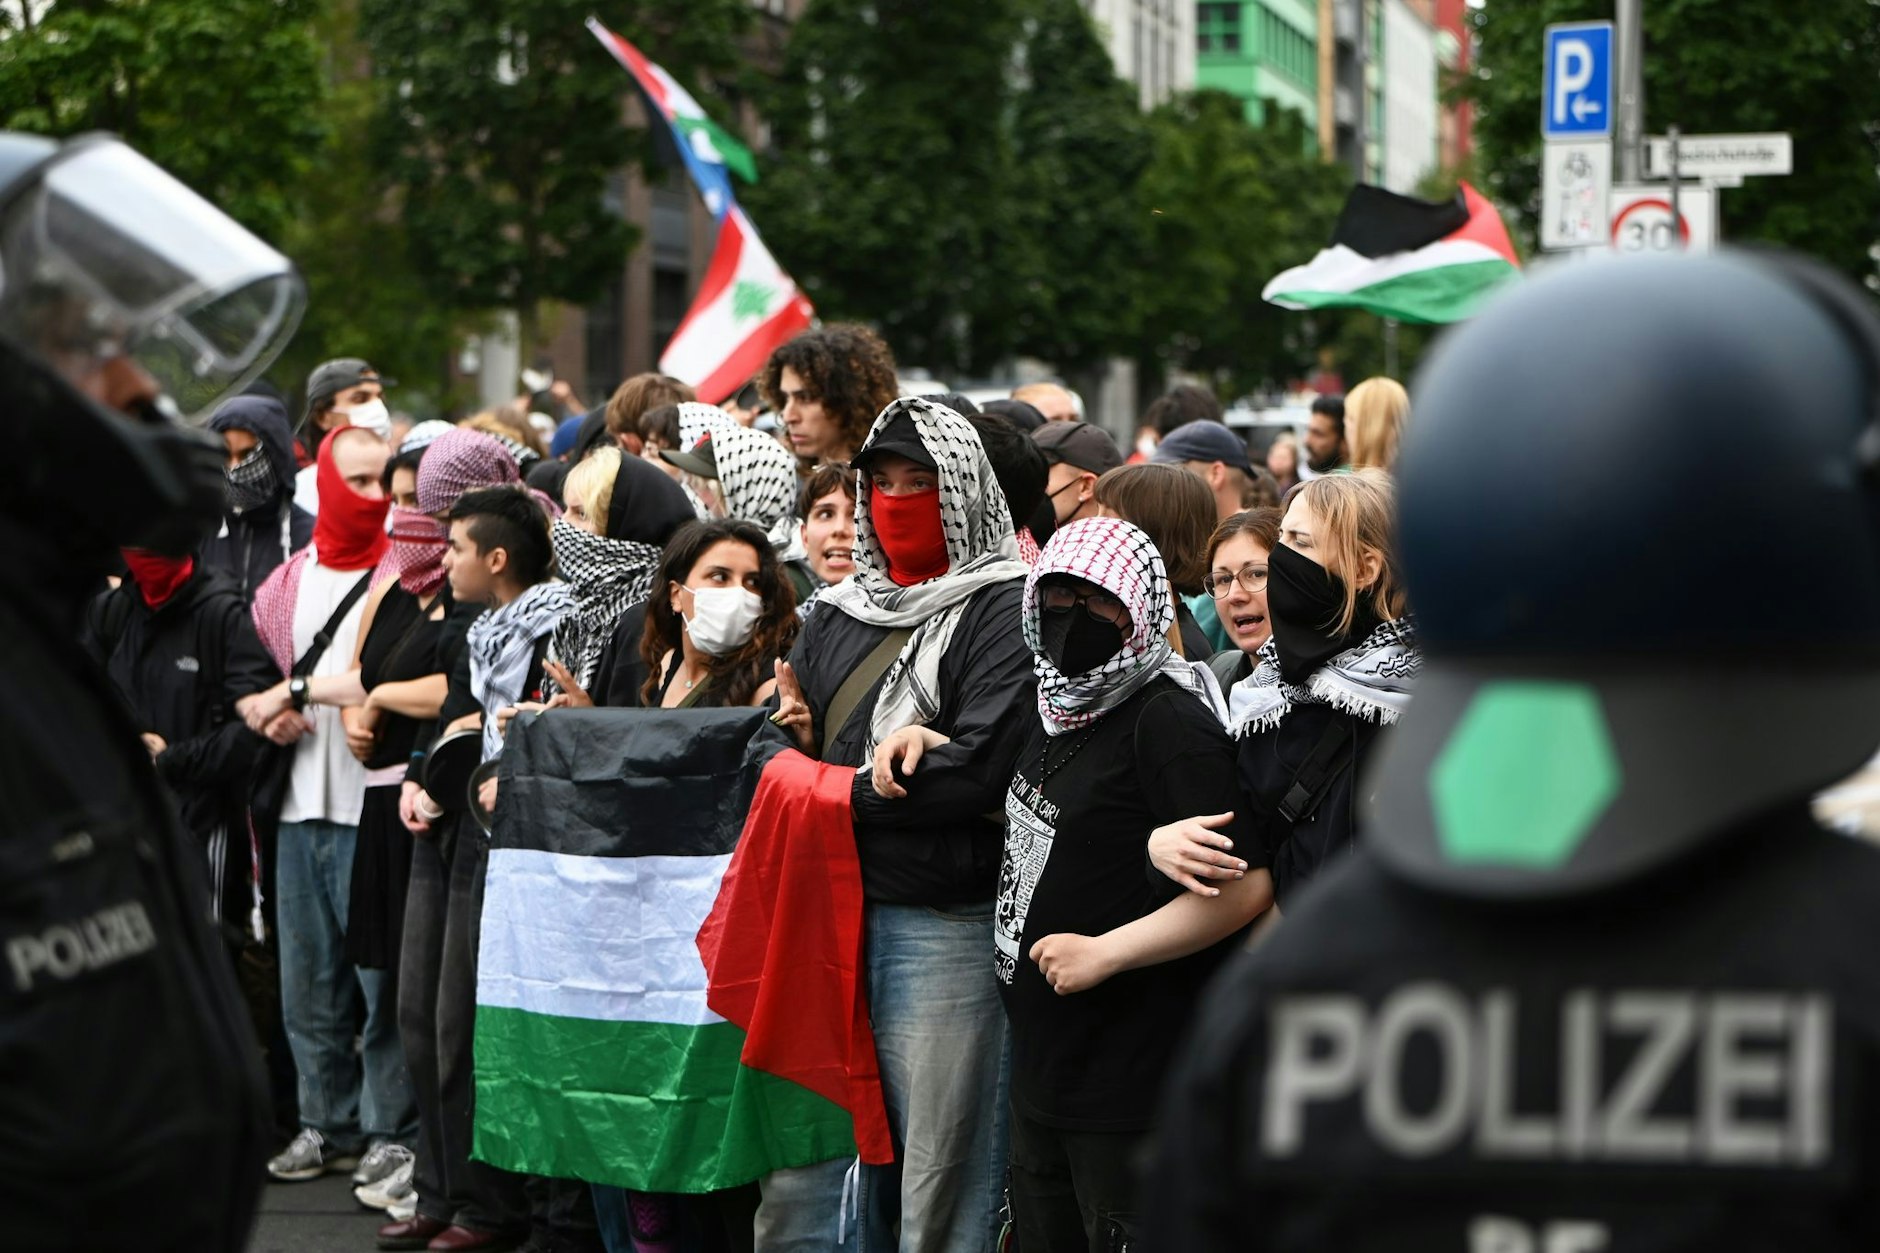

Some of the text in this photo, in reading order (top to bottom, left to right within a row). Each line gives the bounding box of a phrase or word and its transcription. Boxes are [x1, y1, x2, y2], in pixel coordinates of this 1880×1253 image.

[1554, 39, 1593, 124] P
[1625, 219, 1675, 251] 30
[1016, 805, 1037, 825] YOUTH
[1039, 800, 1060, 825] CAR!
[6, 899, 156, 991] POLIZEI
[1001, 954, 1016, 973] TO
[1261, 982, 1832, 1166] POLIZEI
